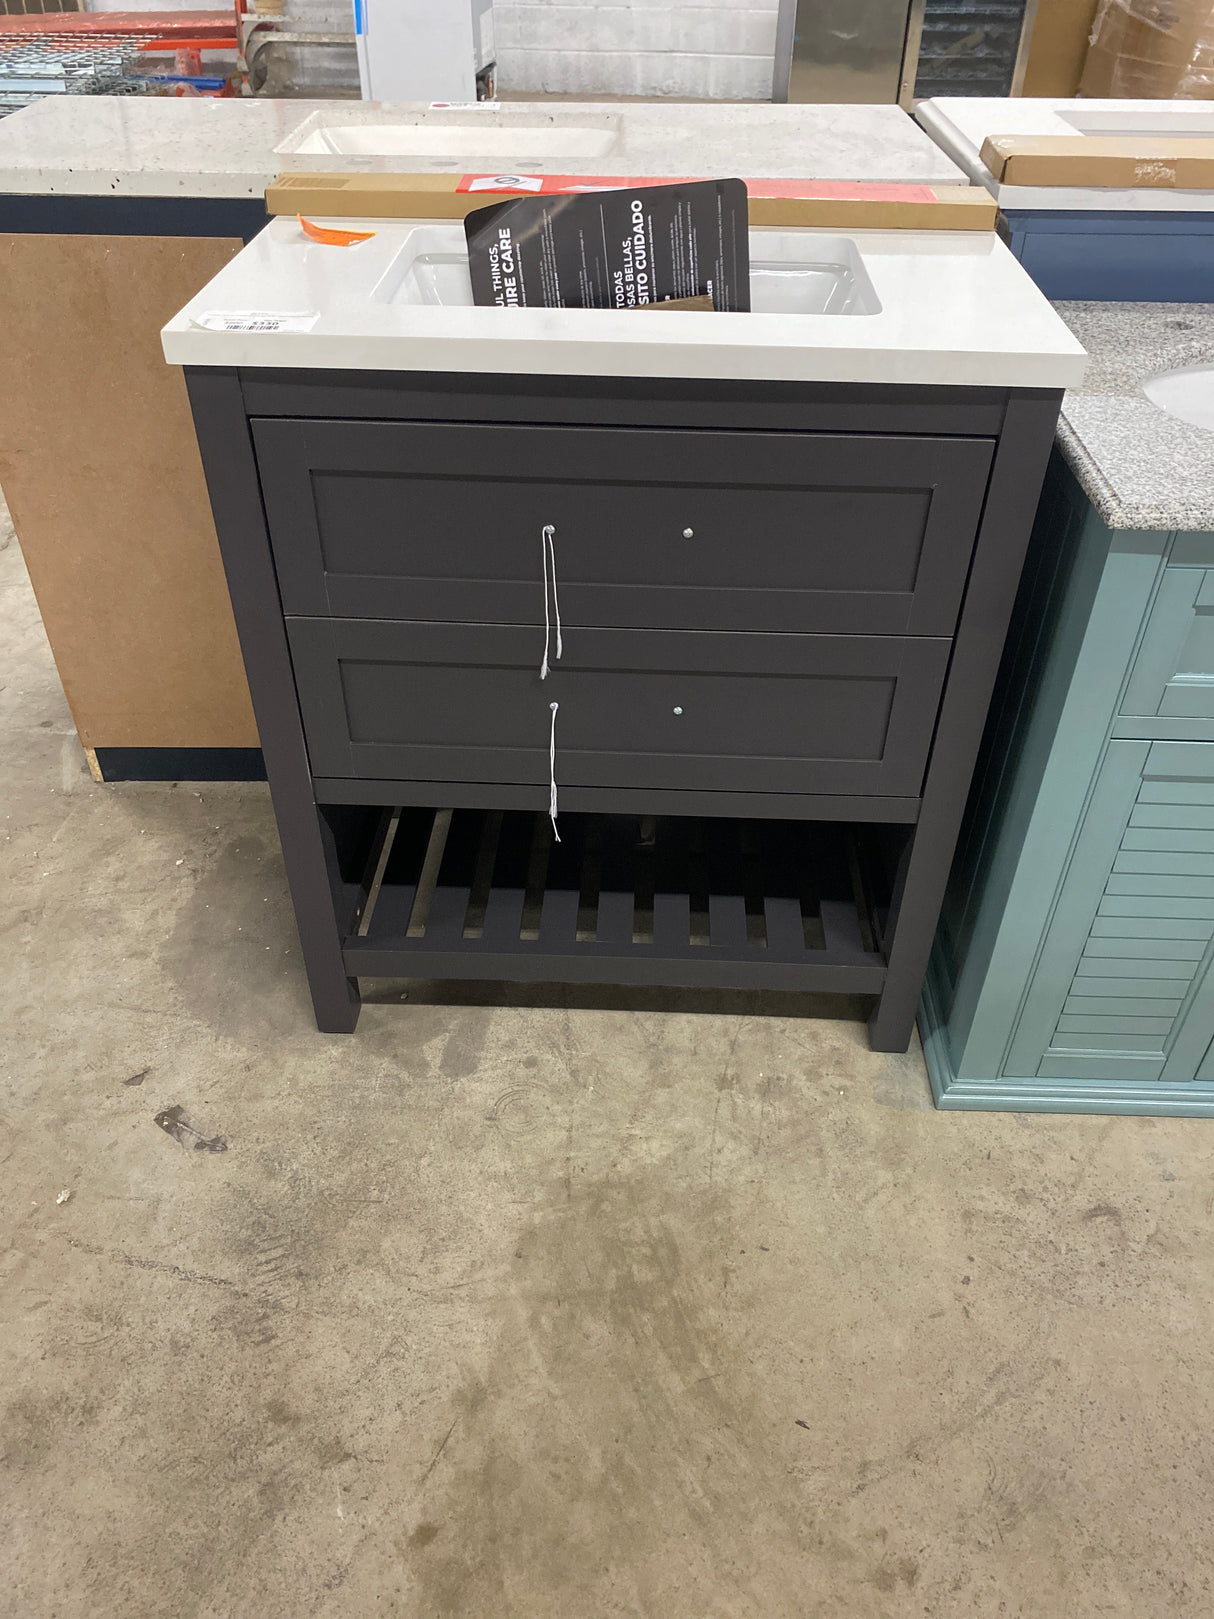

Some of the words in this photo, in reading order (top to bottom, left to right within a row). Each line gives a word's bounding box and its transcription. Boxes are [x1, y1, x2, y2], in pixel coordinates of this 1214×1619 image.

[498, 227, 514, 273] CARE
[630, 200, 647, 270] CUIDADO
[489, 243, 502, 291] THINGS,
[622, 237, 634, 282] BELLAS,
[614, 270, 625, 308] TODAS
